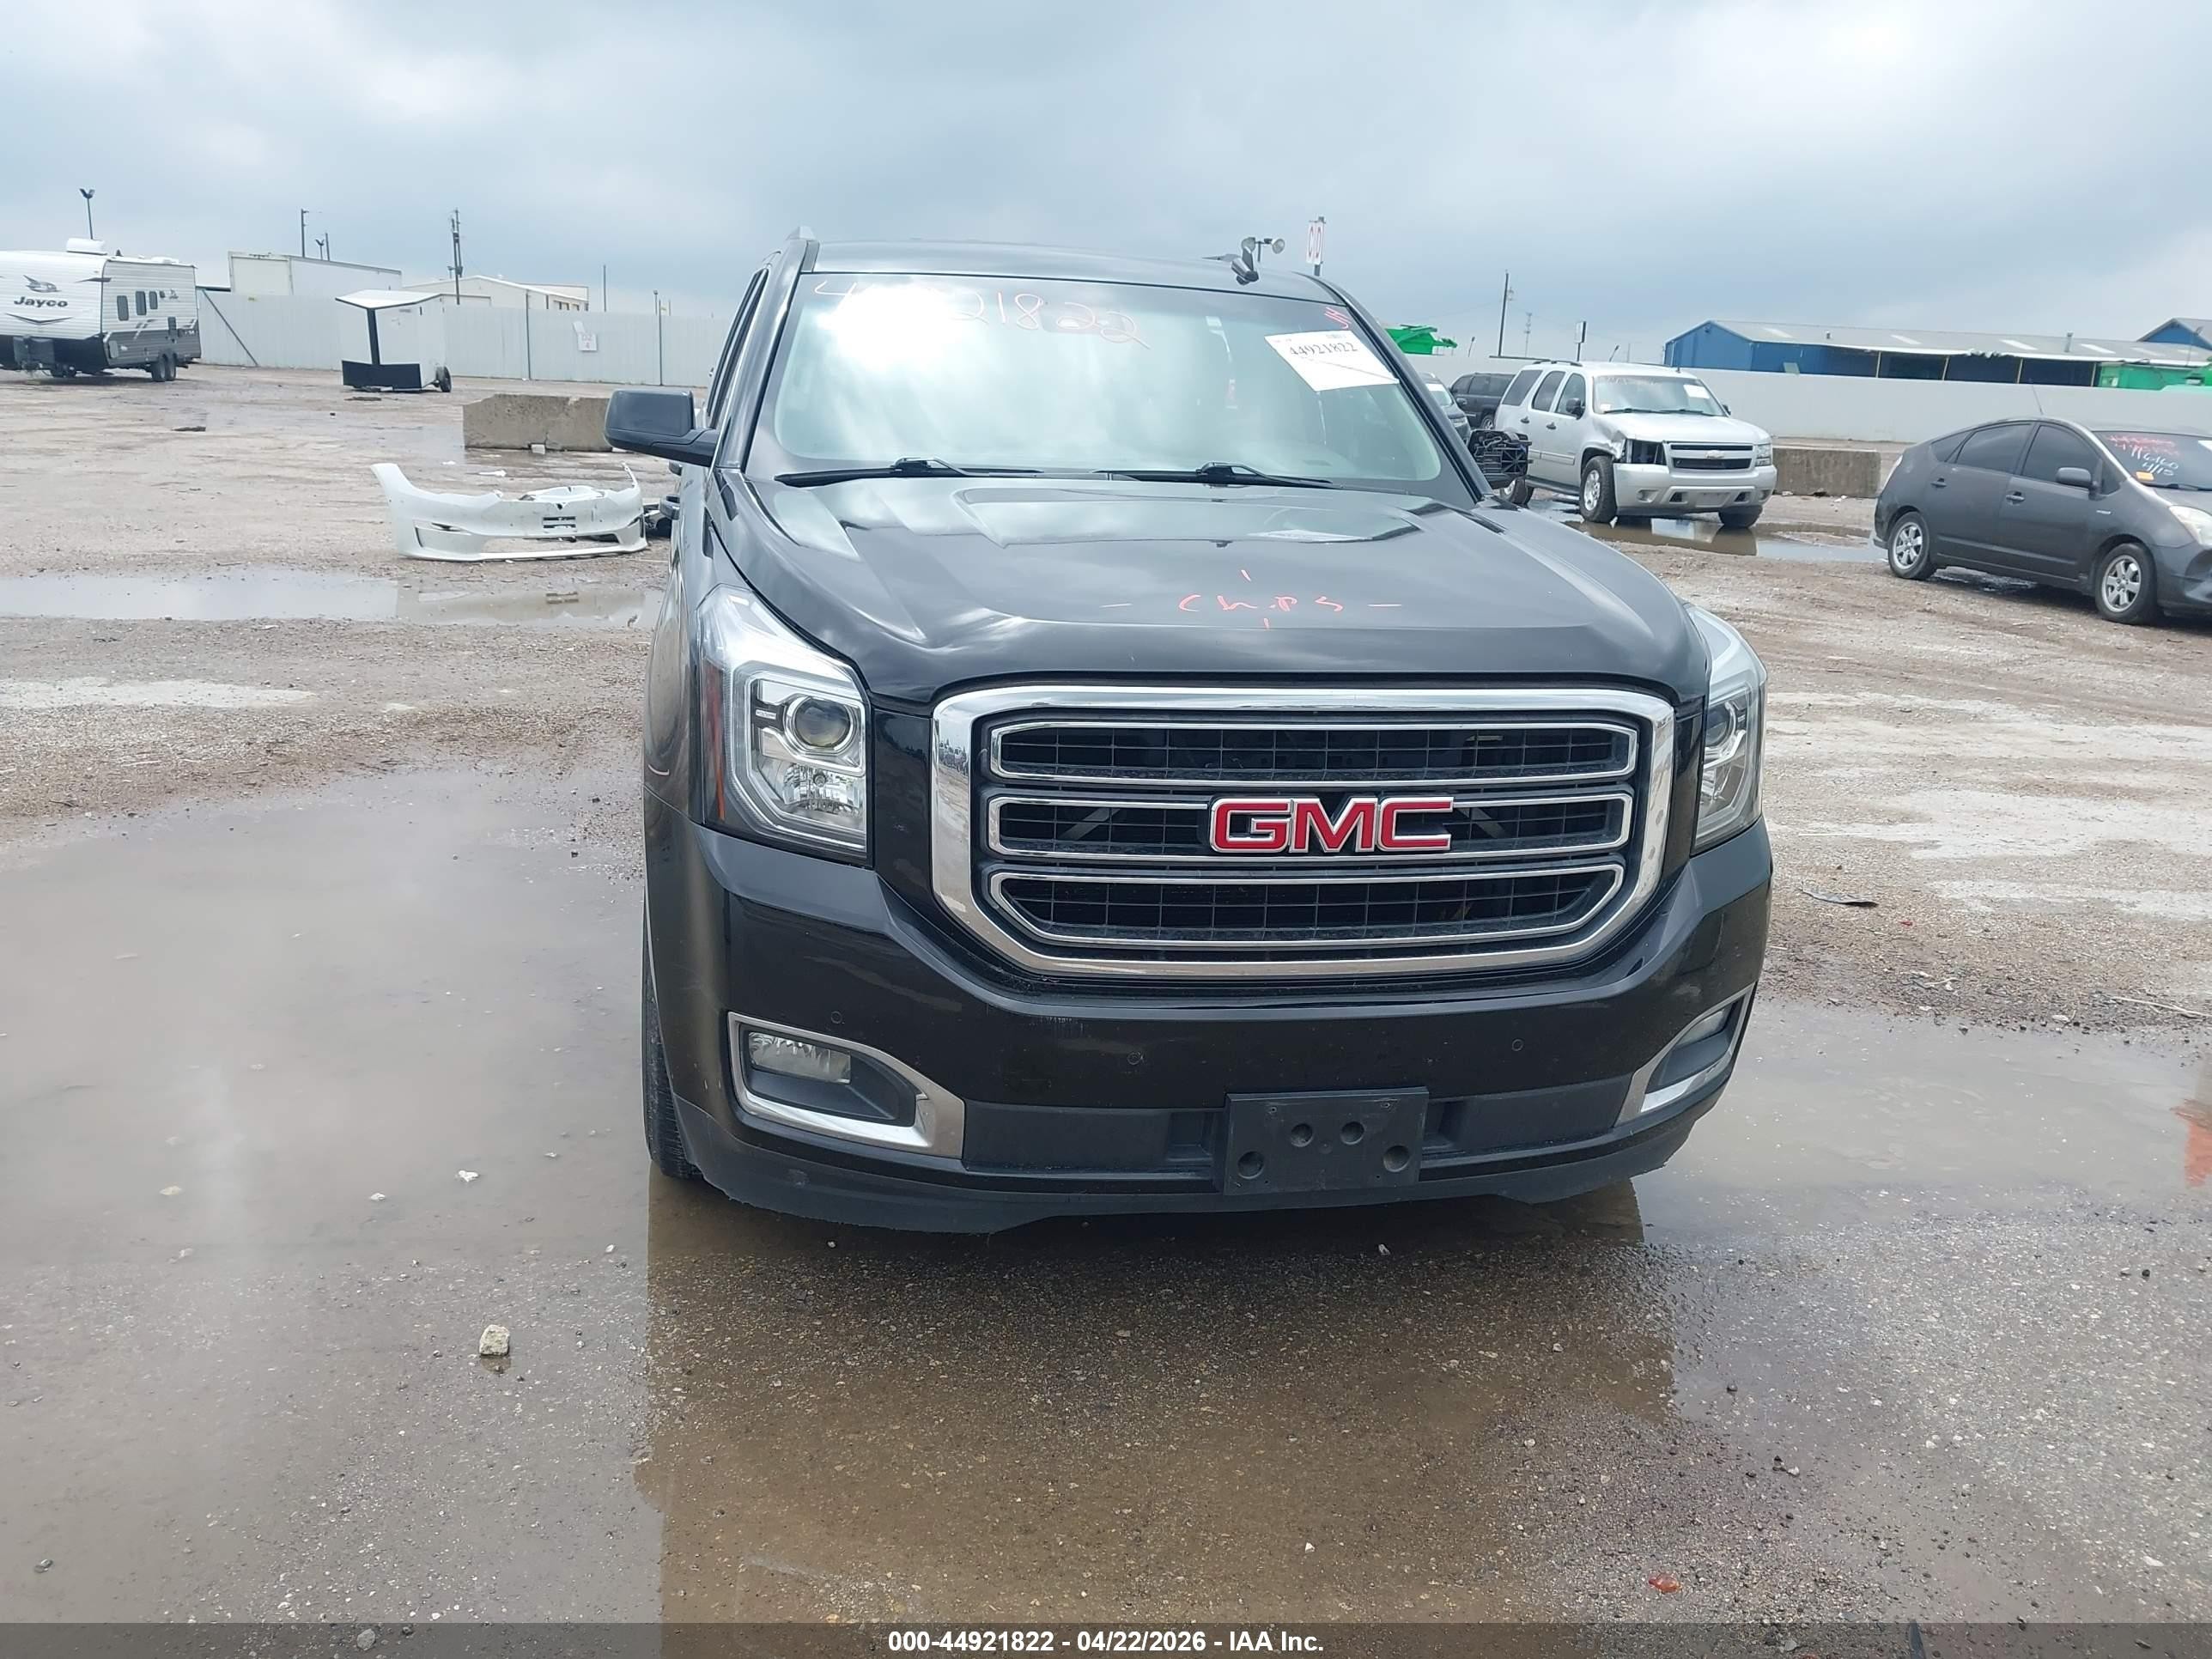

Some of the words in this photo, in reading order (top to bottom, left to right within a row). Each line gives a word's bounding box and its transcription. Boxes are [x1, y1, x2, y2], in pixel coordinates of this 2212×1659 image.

[14, 296, 68, 307] Jayco
[815, 281, 1150, 349] 421822
[1290, 342, 1358, 356] 44921822
[1209, 796, 1455, 854] GMC
